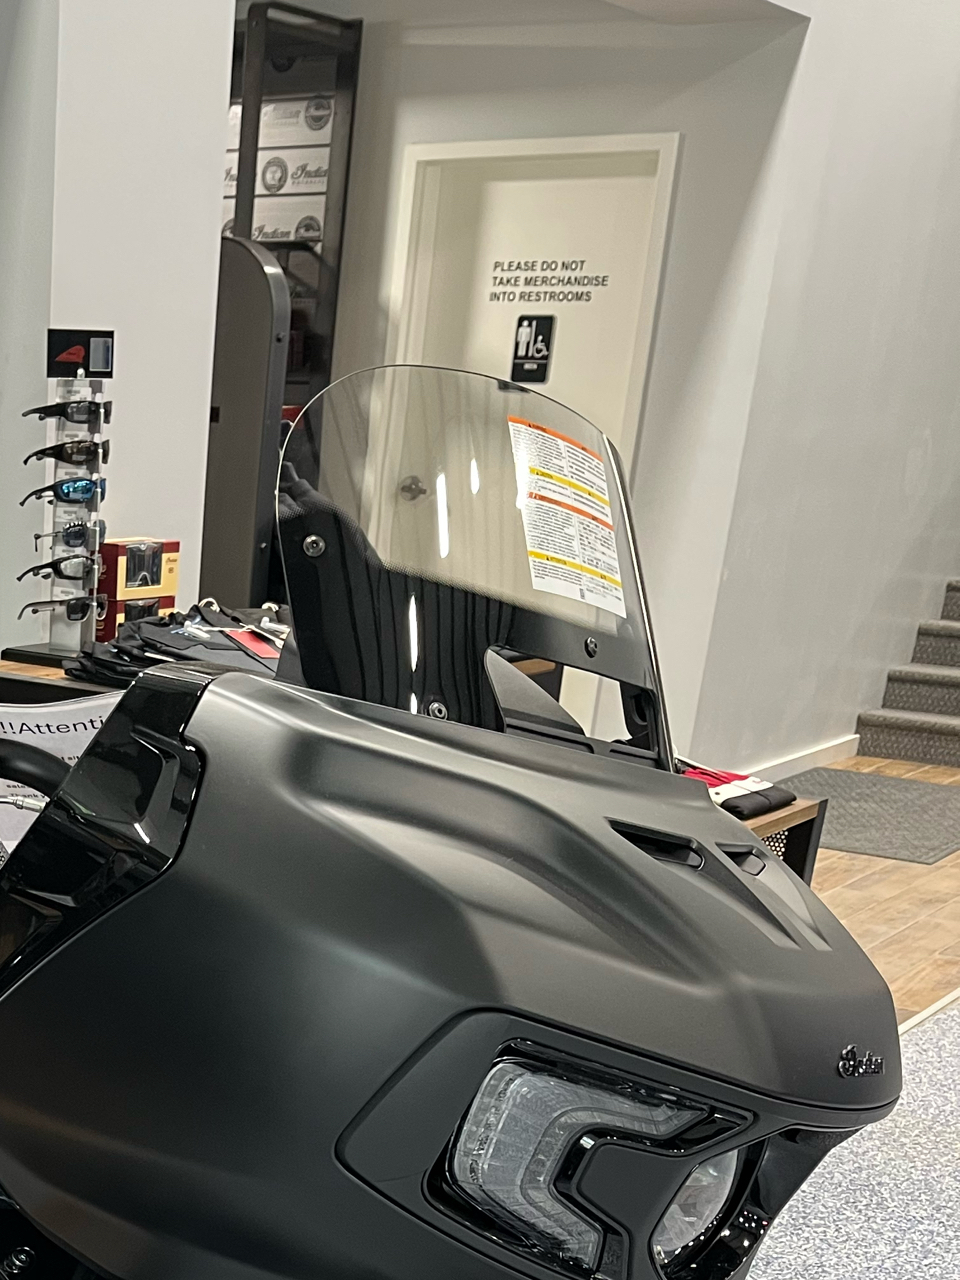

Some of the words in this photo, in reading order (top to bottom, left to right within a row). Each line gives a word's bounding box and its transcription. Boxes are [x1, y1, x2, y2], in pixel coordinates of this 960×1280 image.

[493, 260, 538, 272] PLEASE
[540, 260, 558, 271] DO
[560, 260, 586, 271] NOT
[492, 276, 521, 287] TAKE
[523, 275, 609, 287] MERCHANDISE
[489, 291, 516, 302] INTO
[518, 291, 592, 302] RESTROOMS
[838, 1044, 885, 1079] Indian
